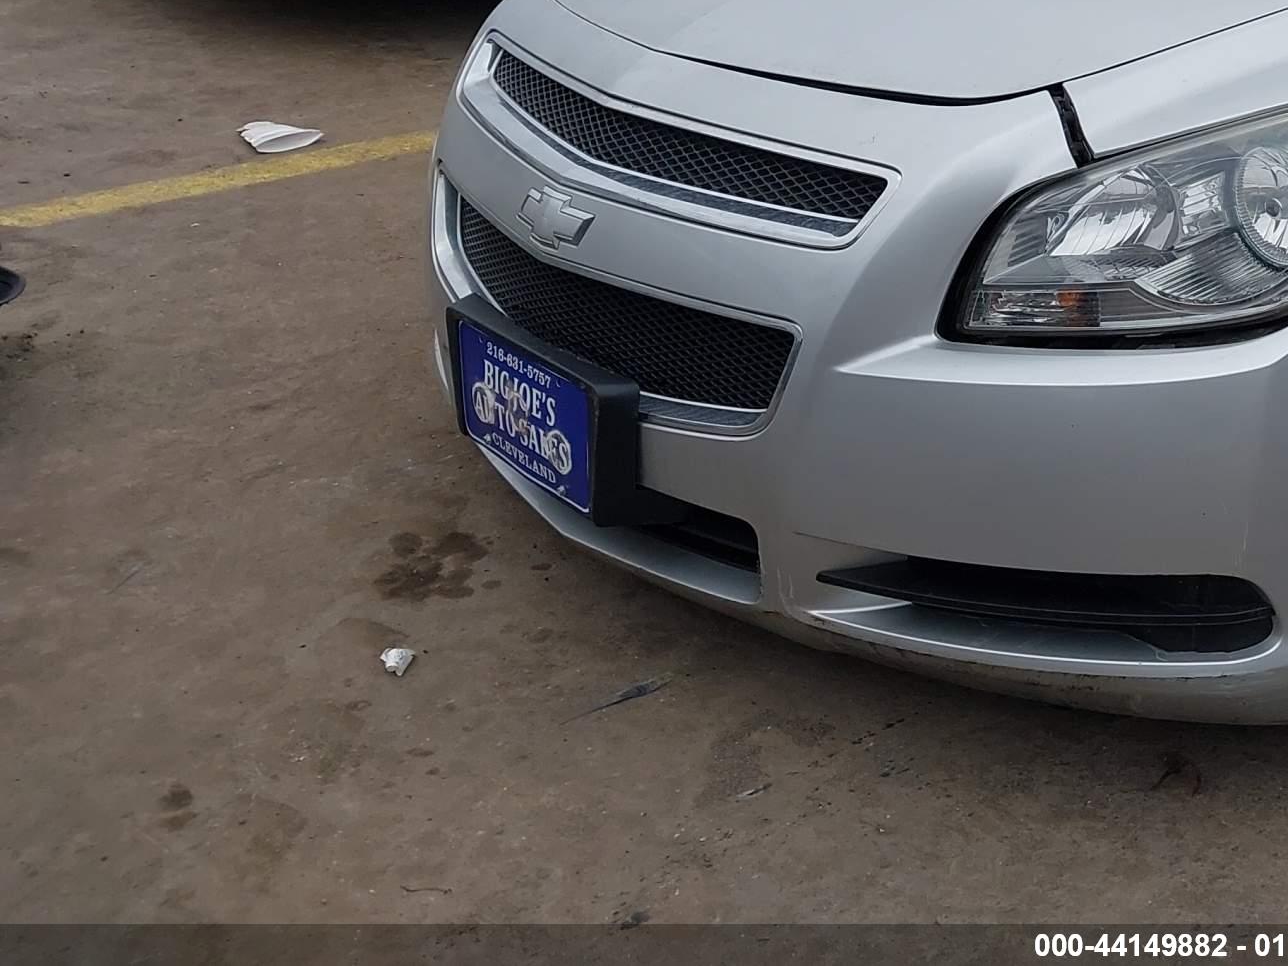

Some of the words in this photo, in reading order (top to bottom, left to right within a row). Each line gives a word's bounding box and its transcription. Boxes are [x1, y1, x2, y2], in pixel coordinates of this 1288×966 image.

[484, 359, 509, 401] BIG
[512, 378, 556, 427] JOE'S
[492, 433, 556, 484] CLEVELAND
